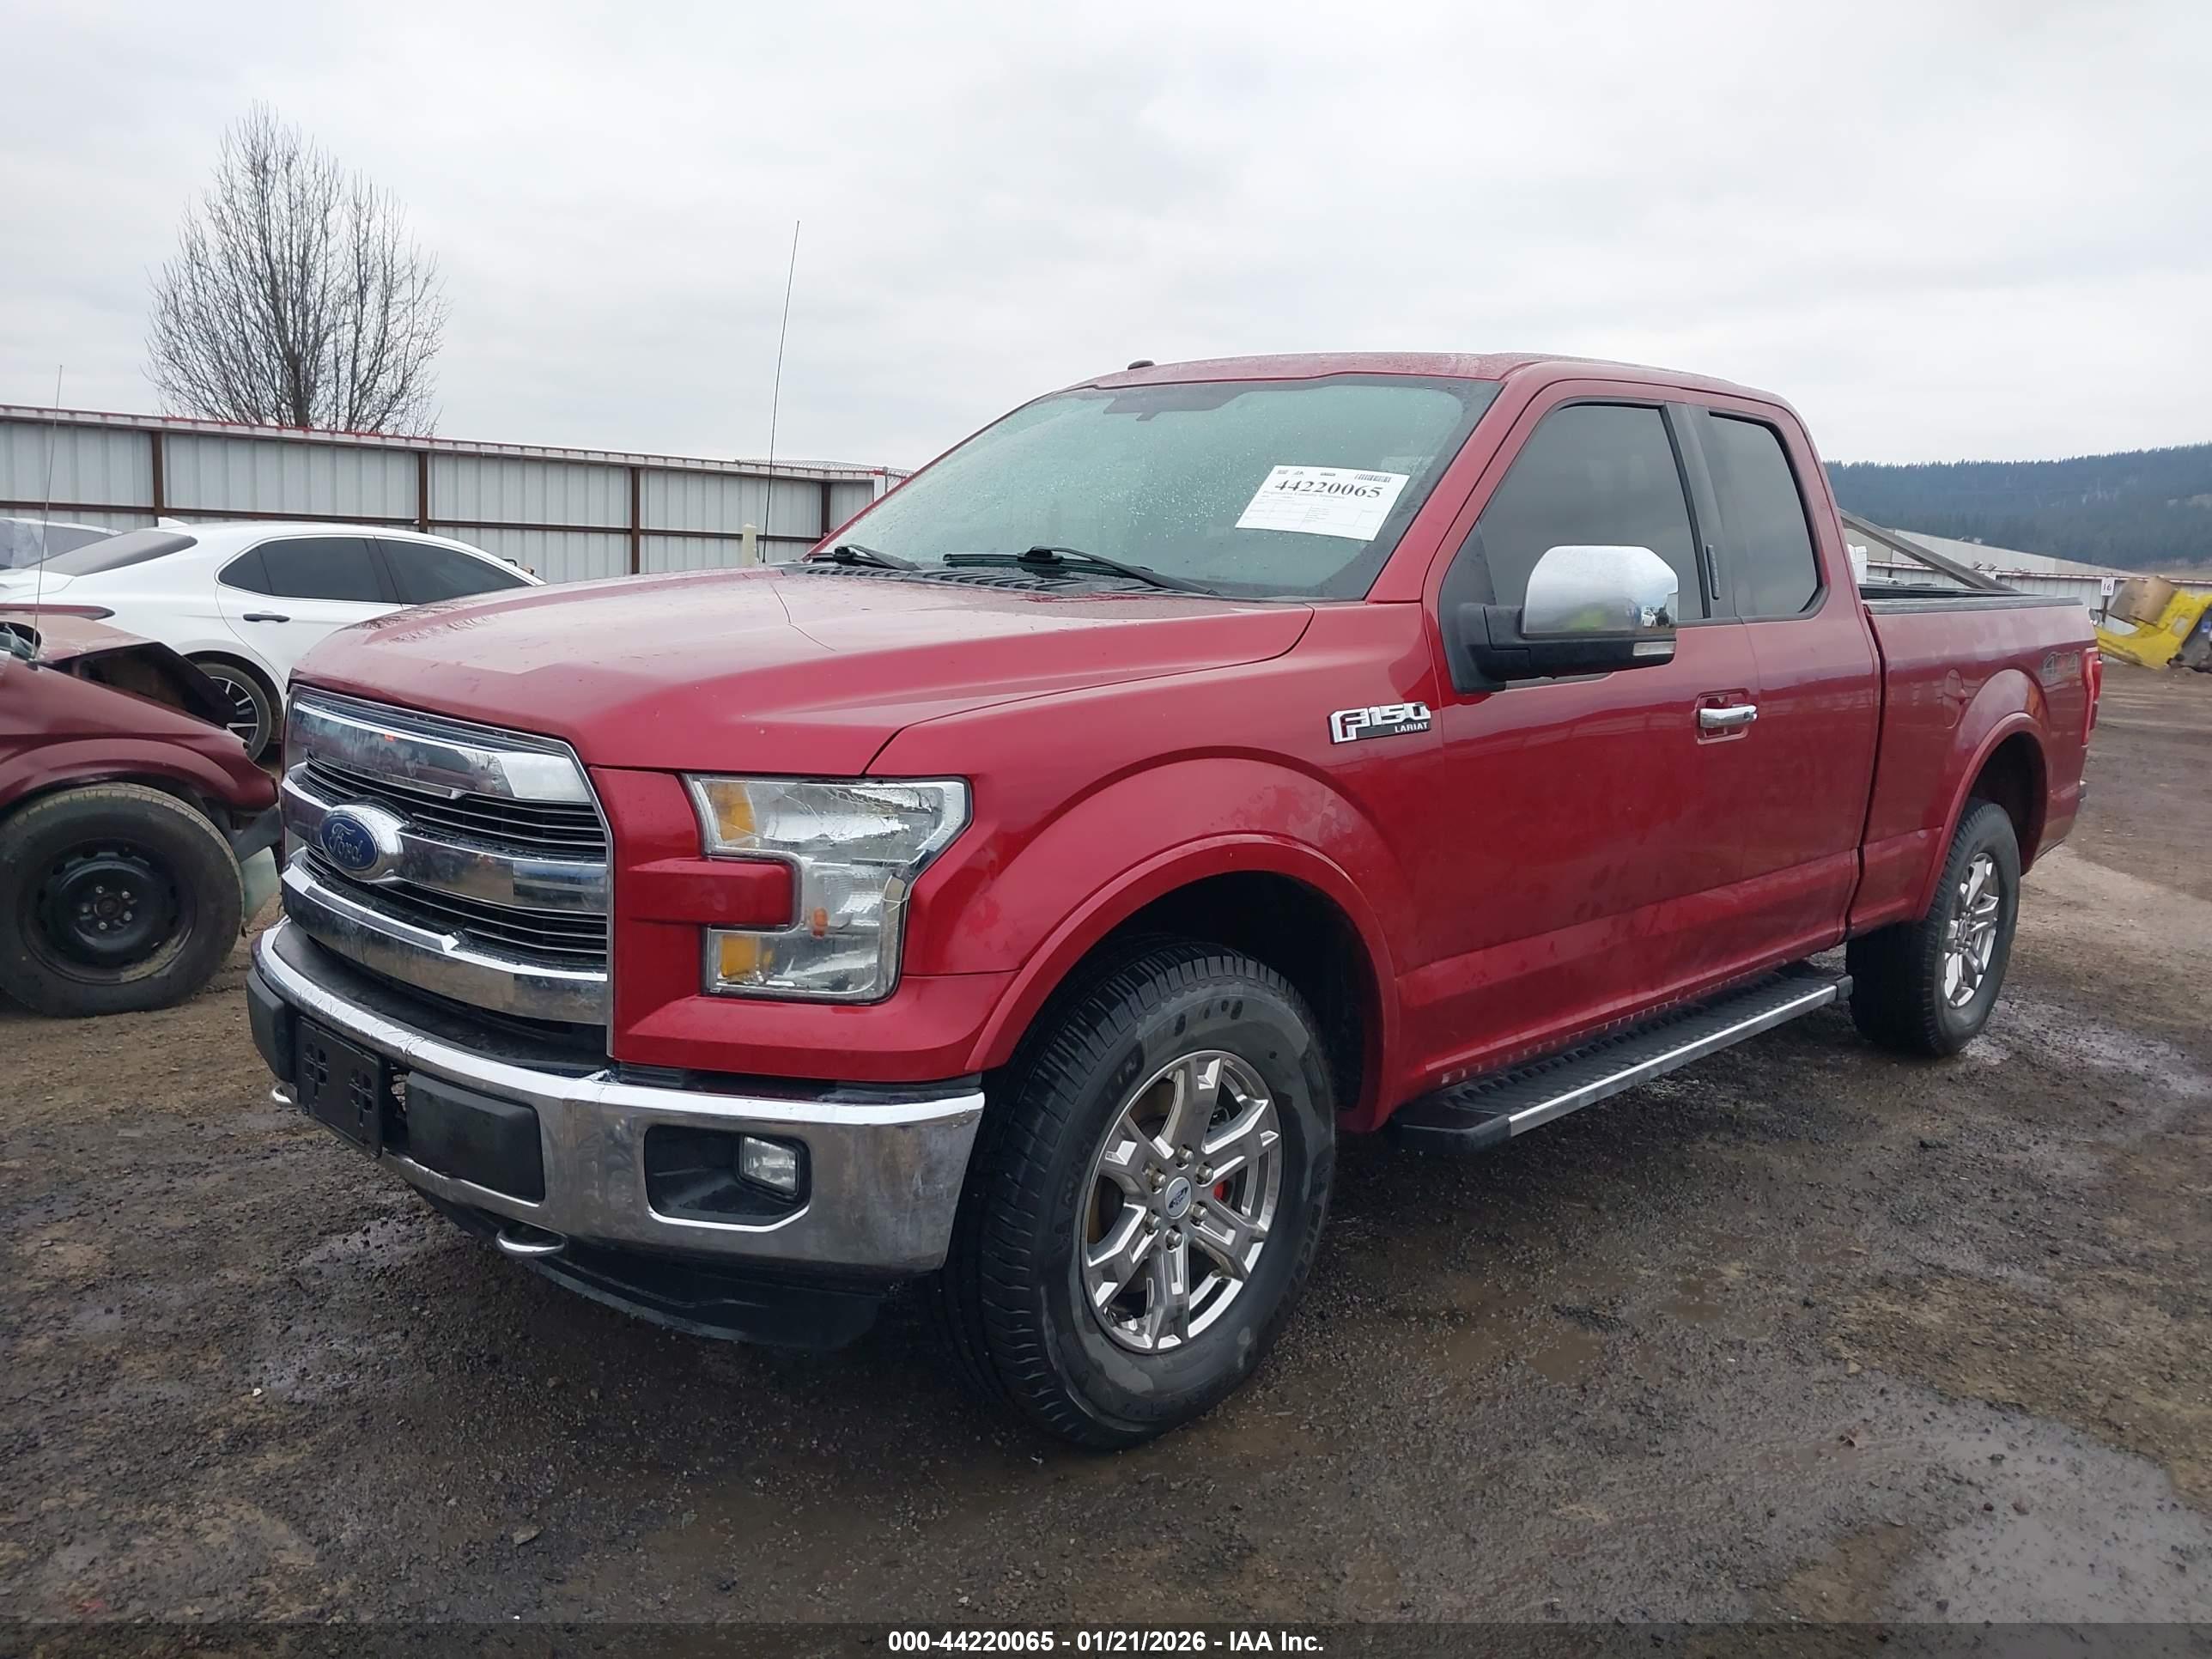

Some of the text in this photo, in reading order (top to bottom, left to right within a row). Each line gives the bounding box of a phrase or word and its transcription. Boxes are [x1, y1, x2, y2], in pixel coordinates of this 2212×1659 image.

[1274, 480, 1383, 499] 44220065
[2103, 583, 2112, 592] 16
[1394, 721, 1429, 733] LARIAT
[328, 822, 364, 863] Ford
